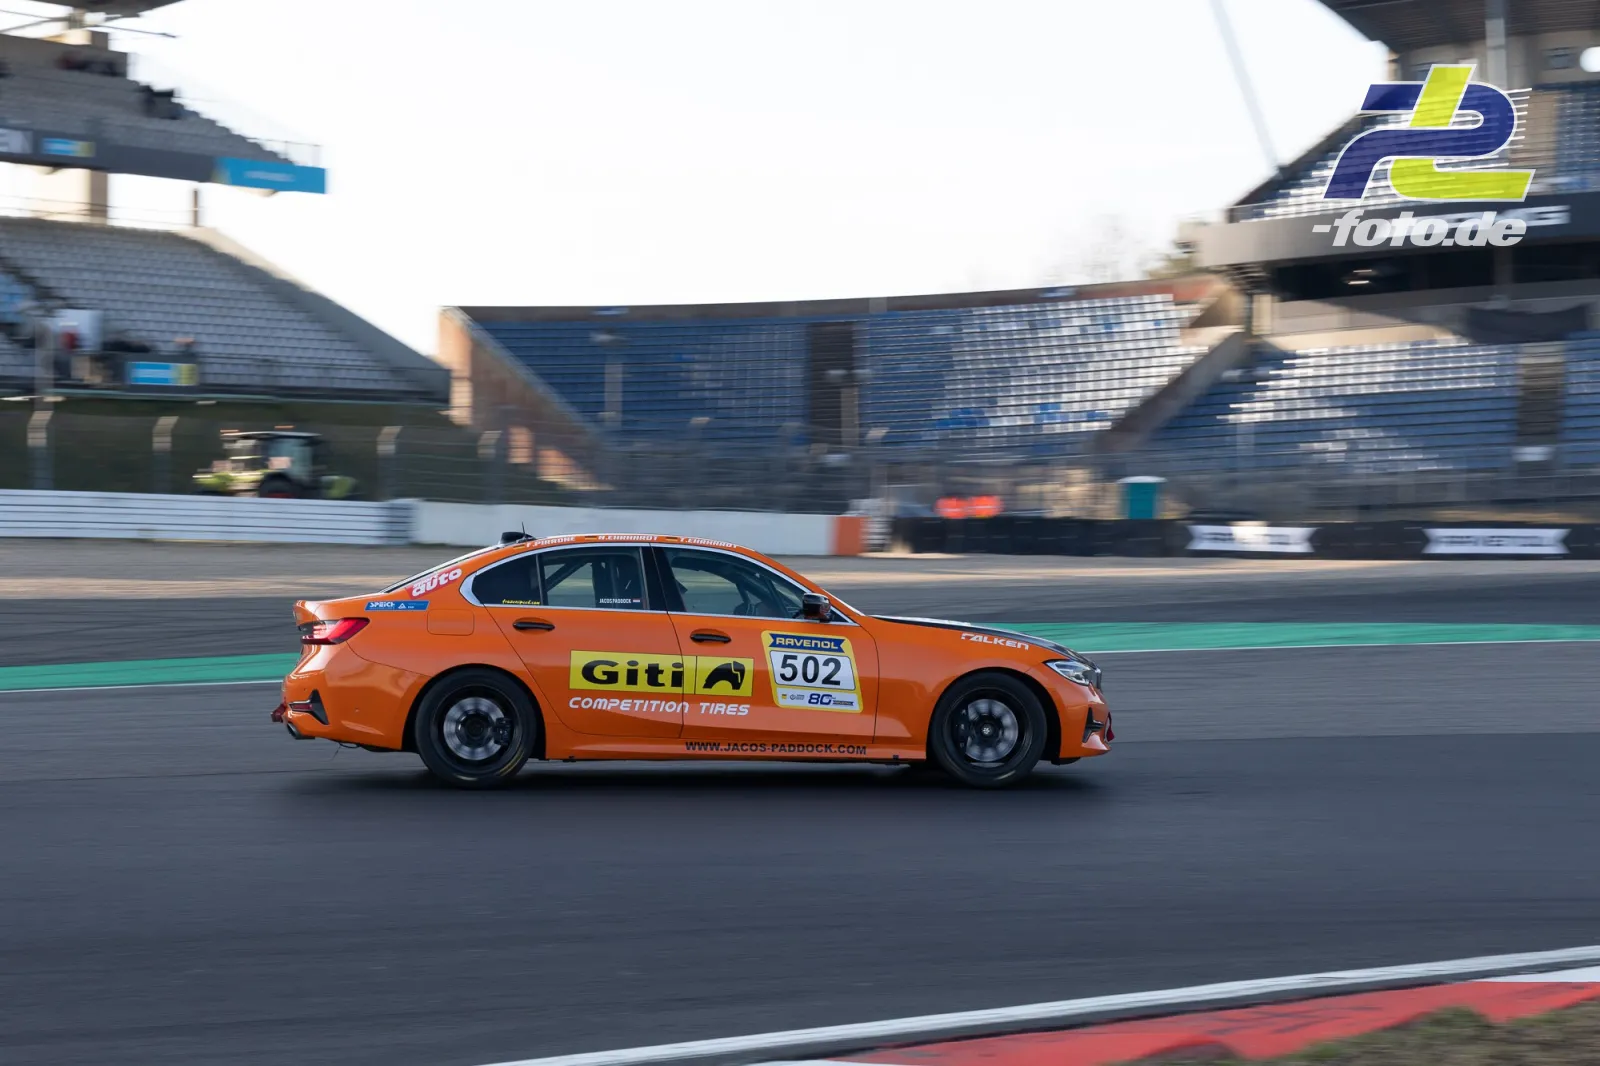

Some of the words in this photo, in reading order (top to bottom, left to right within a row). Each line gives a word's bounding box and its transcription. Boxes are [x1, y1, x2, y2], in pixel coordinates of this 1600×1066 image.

[411, 568, 462, 597] auto
[775, 637, 839, 650] RAVENOL
[960, 633, 1029, 651] FALKEN
[581, 659, 685, 688] Giti
[779, 654, 842, 686] 502
[569, 697, 689, 714] COMPETITION
[700, 702, 750, 716] TIRES
[685, 741, 867, 755] WWW.JACOS-PADDOCK.COM
